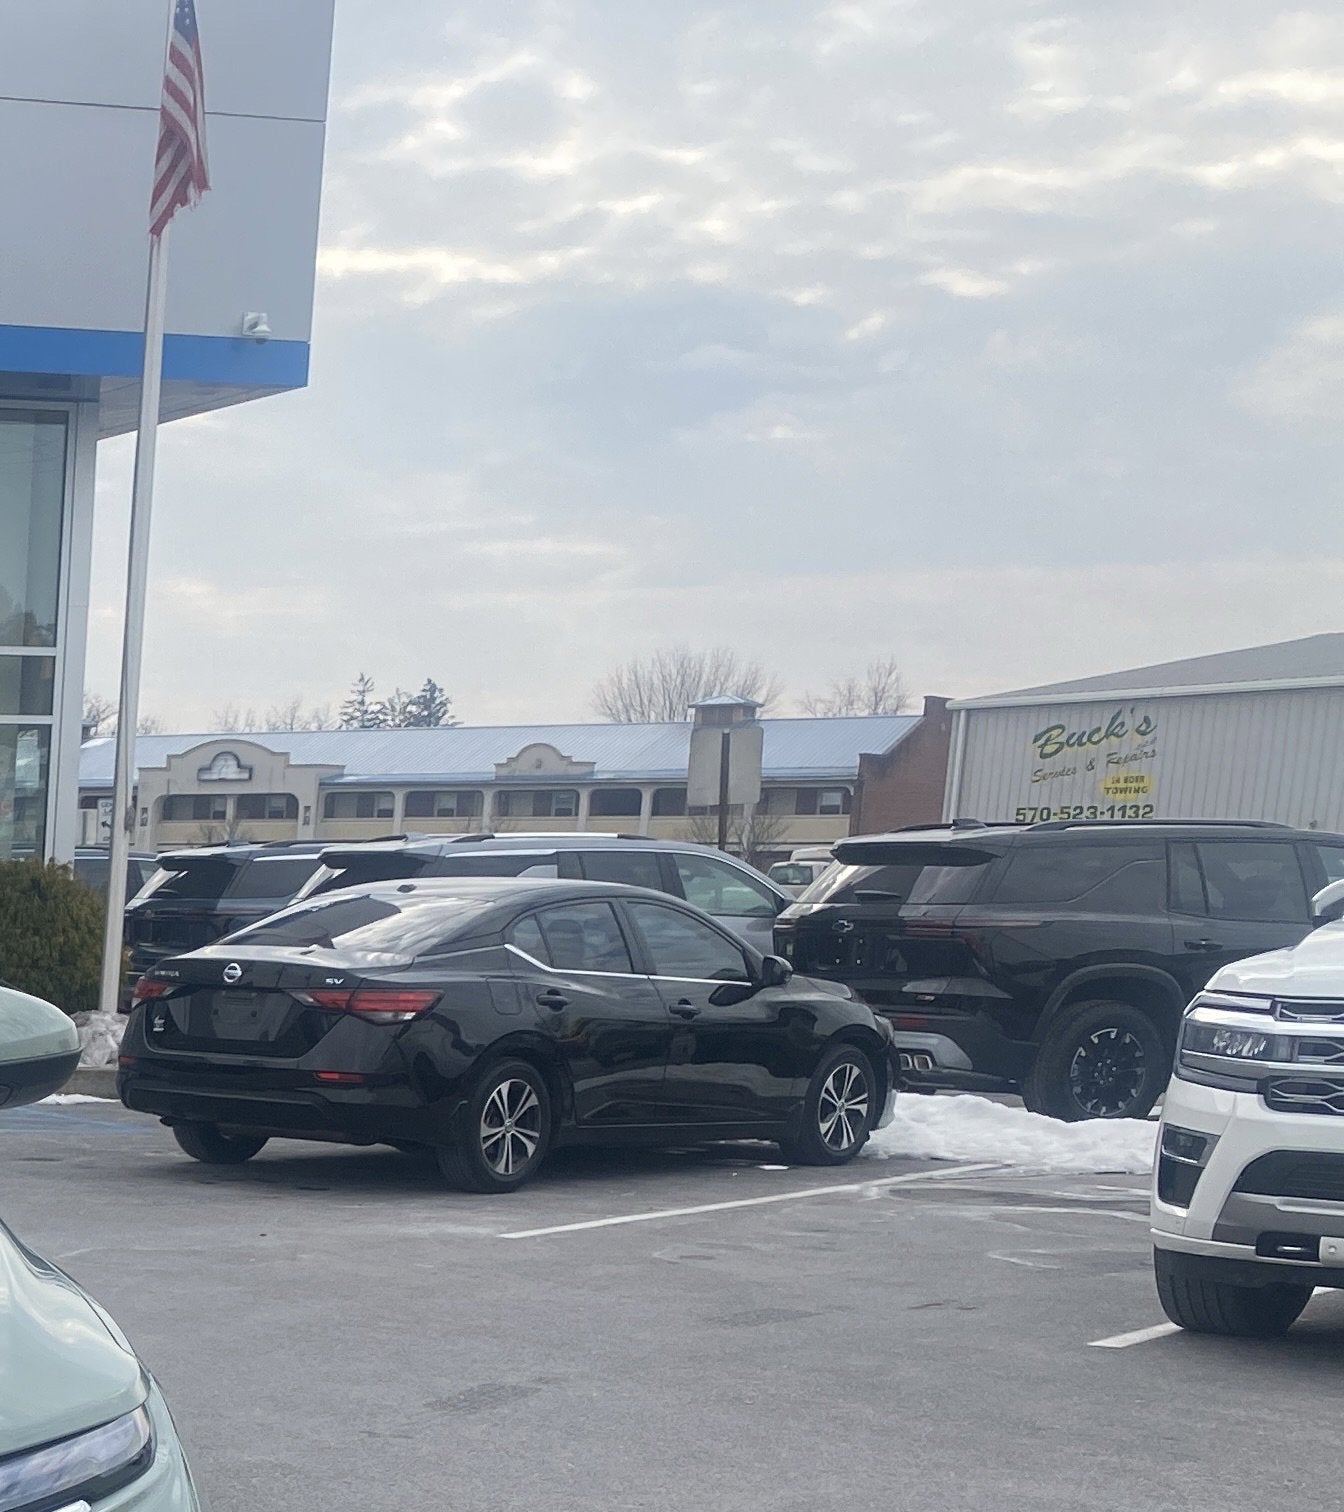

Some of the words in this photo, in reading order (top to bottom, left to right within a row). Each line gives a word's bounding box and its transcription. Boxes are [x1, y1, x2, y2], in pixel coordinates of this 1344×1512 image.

[1032, 707, 1157, 760] Buck's
[1086, 757, 1095, 771] &
[1103, 786, 1149, 795] TOWING
[1015, 804, 1154, 822] 570-523-1132
[325, 977, 345, 985] SV
